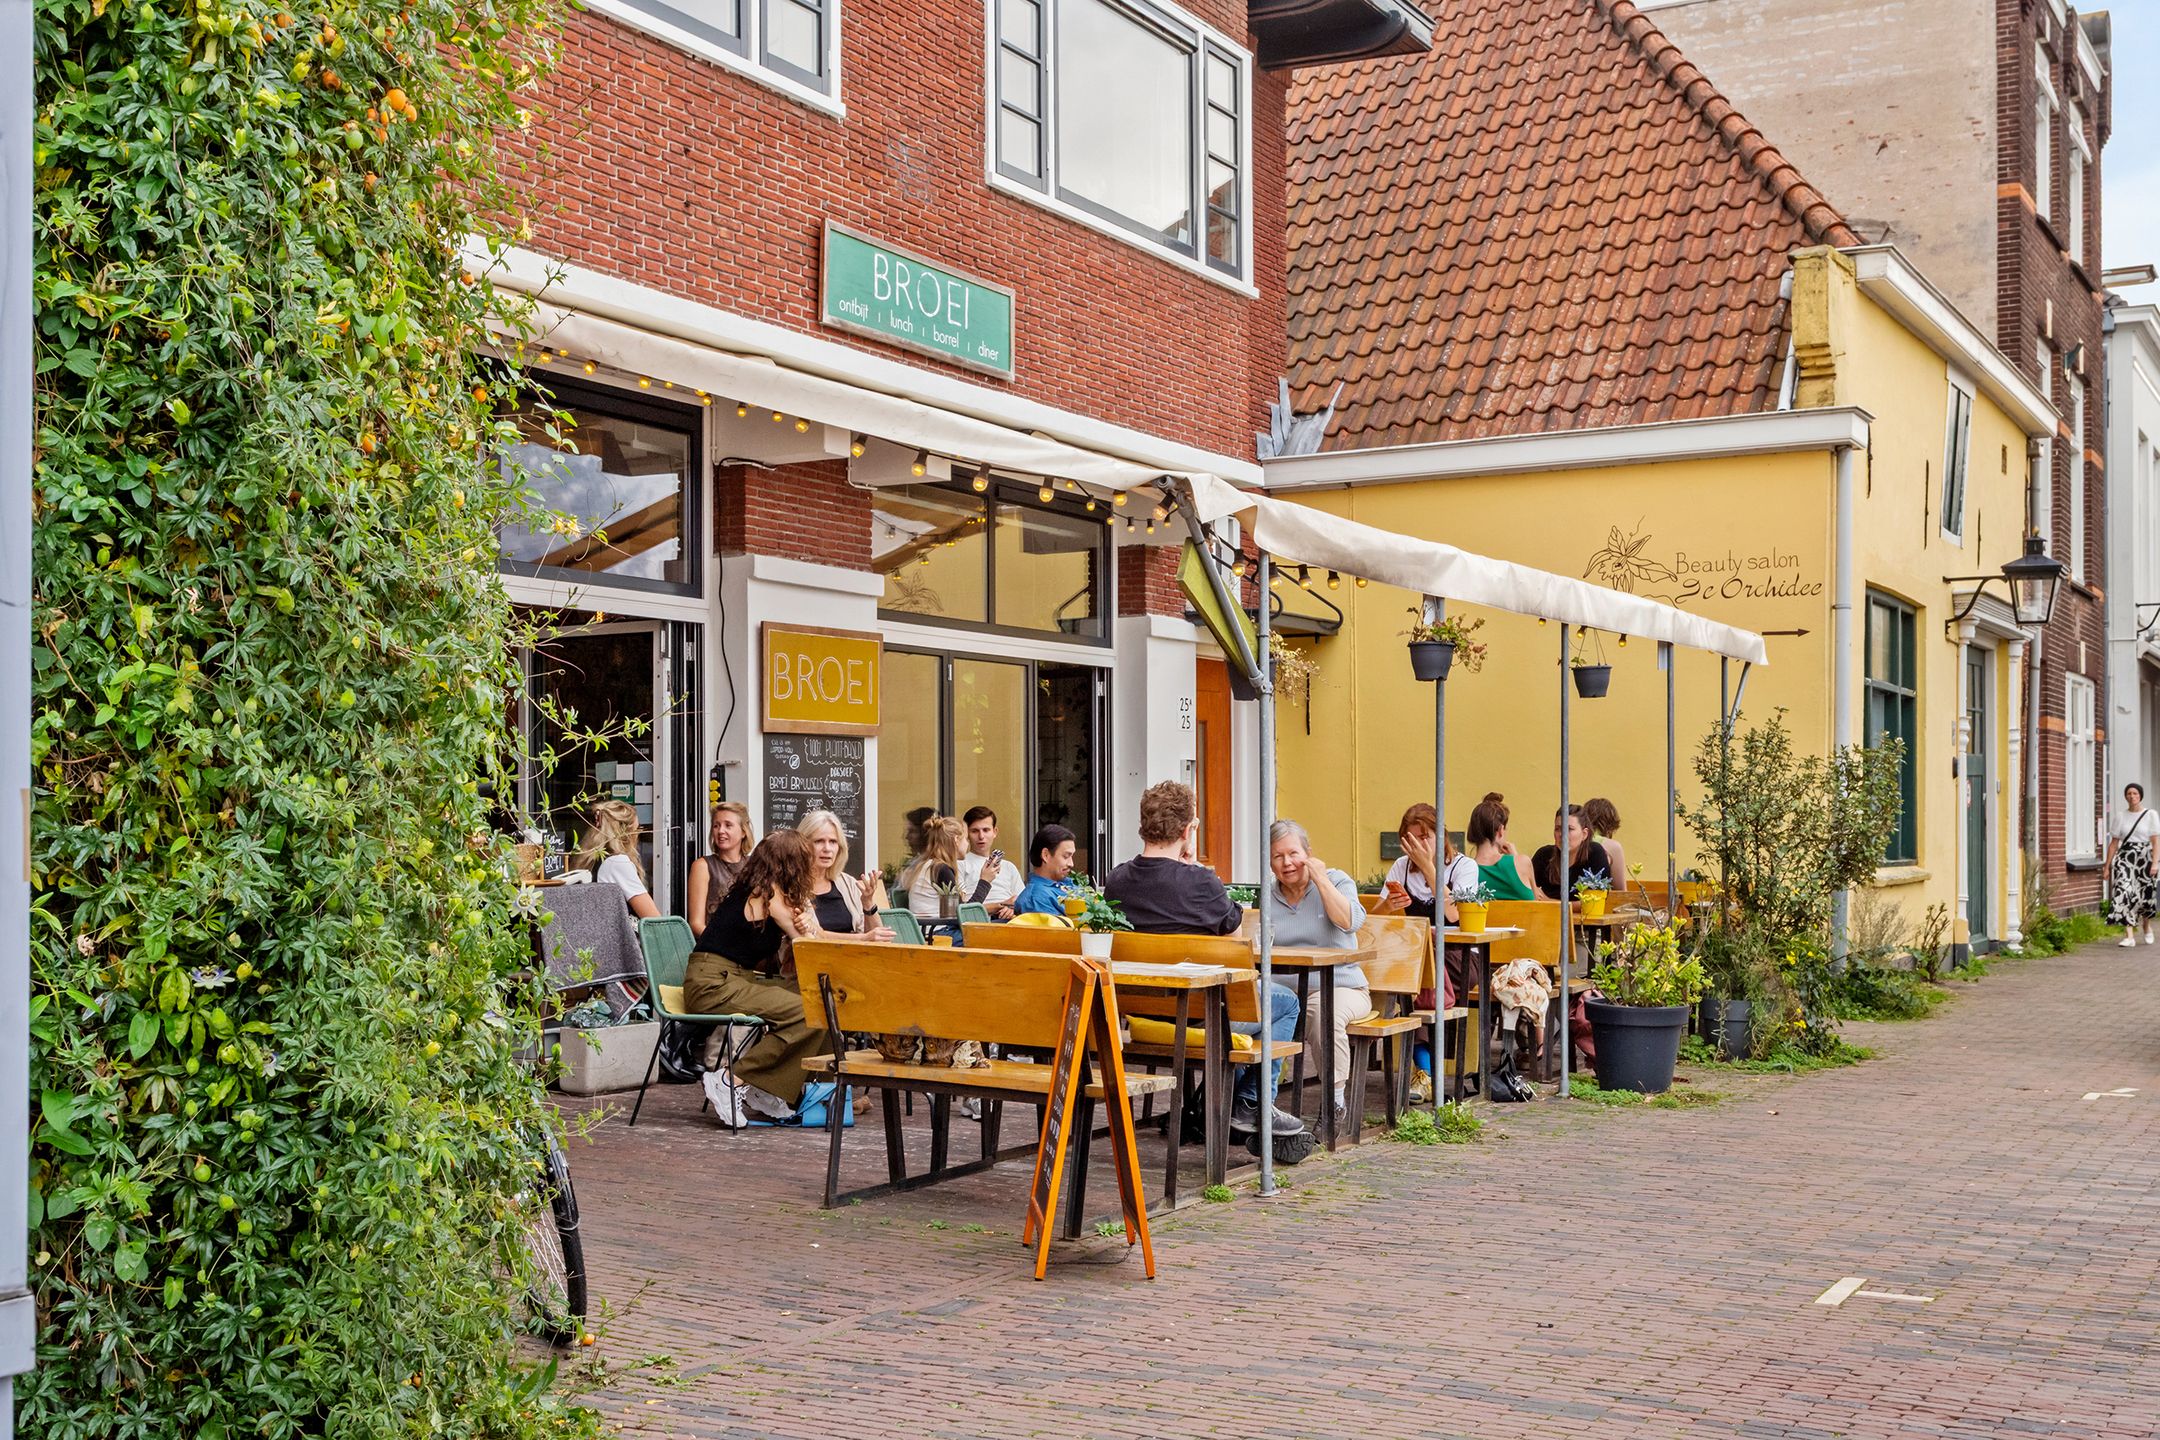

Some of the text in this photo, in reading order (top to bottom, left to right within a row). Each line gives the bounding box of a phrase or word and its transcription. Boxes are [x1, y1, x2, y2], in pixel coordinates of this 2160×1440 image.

[873, 252, 970, 330] BROEI
[838, 298, 999, 362] ontbijt lunch borrel diner
[1675, 546, 1800, 579] Beauty salon
[1720, 573, 1823, 600] Orchidee
[773, 652, 873, 705] BROEI
[1181, 715, 1191, 730] 25
